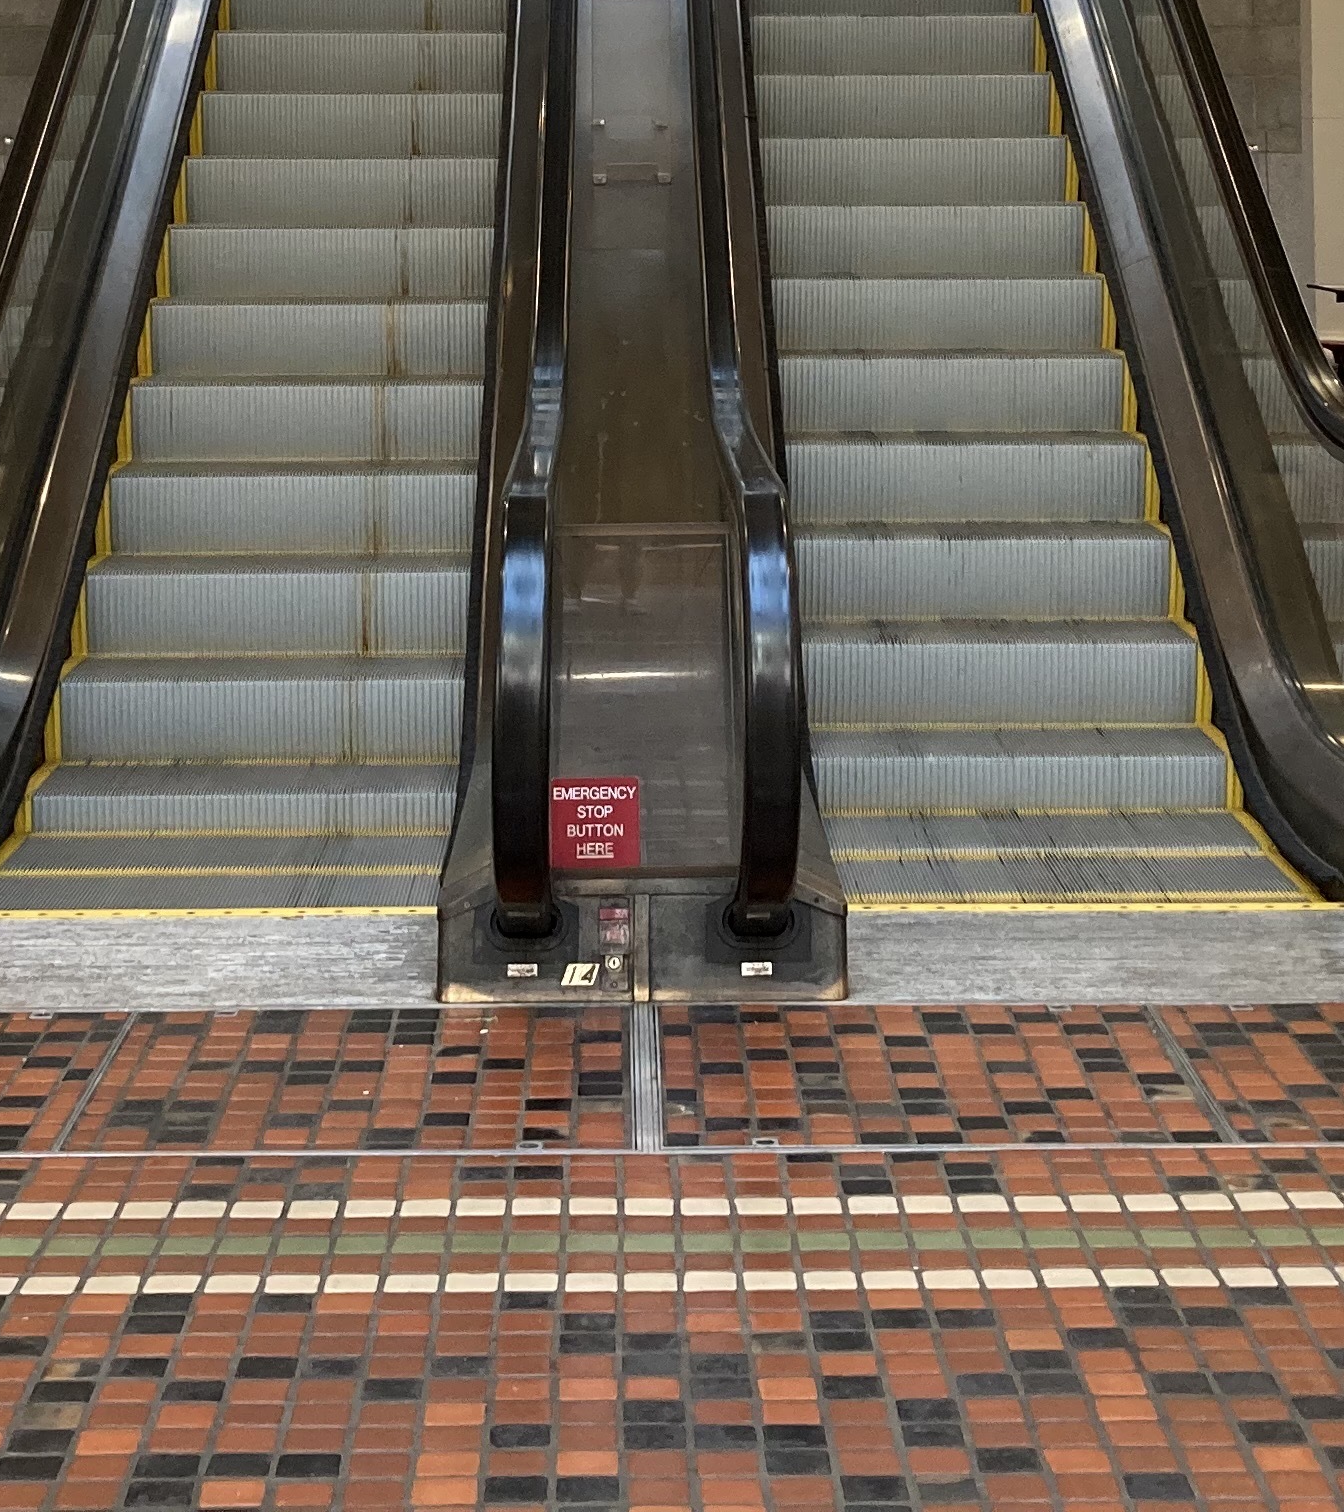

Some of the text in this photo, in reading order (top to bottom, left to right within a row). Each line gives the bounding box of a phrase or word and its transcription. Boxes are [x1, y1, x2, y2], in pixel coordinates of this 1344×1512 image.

[552, 786, 637, 801] EMERGENCY
[576, 805, 614, 819] STOP
[566, 823, 624, 837] BUTTON
[576, 842, 614, 857] HERE
[568, 964, 596, 984] 14
